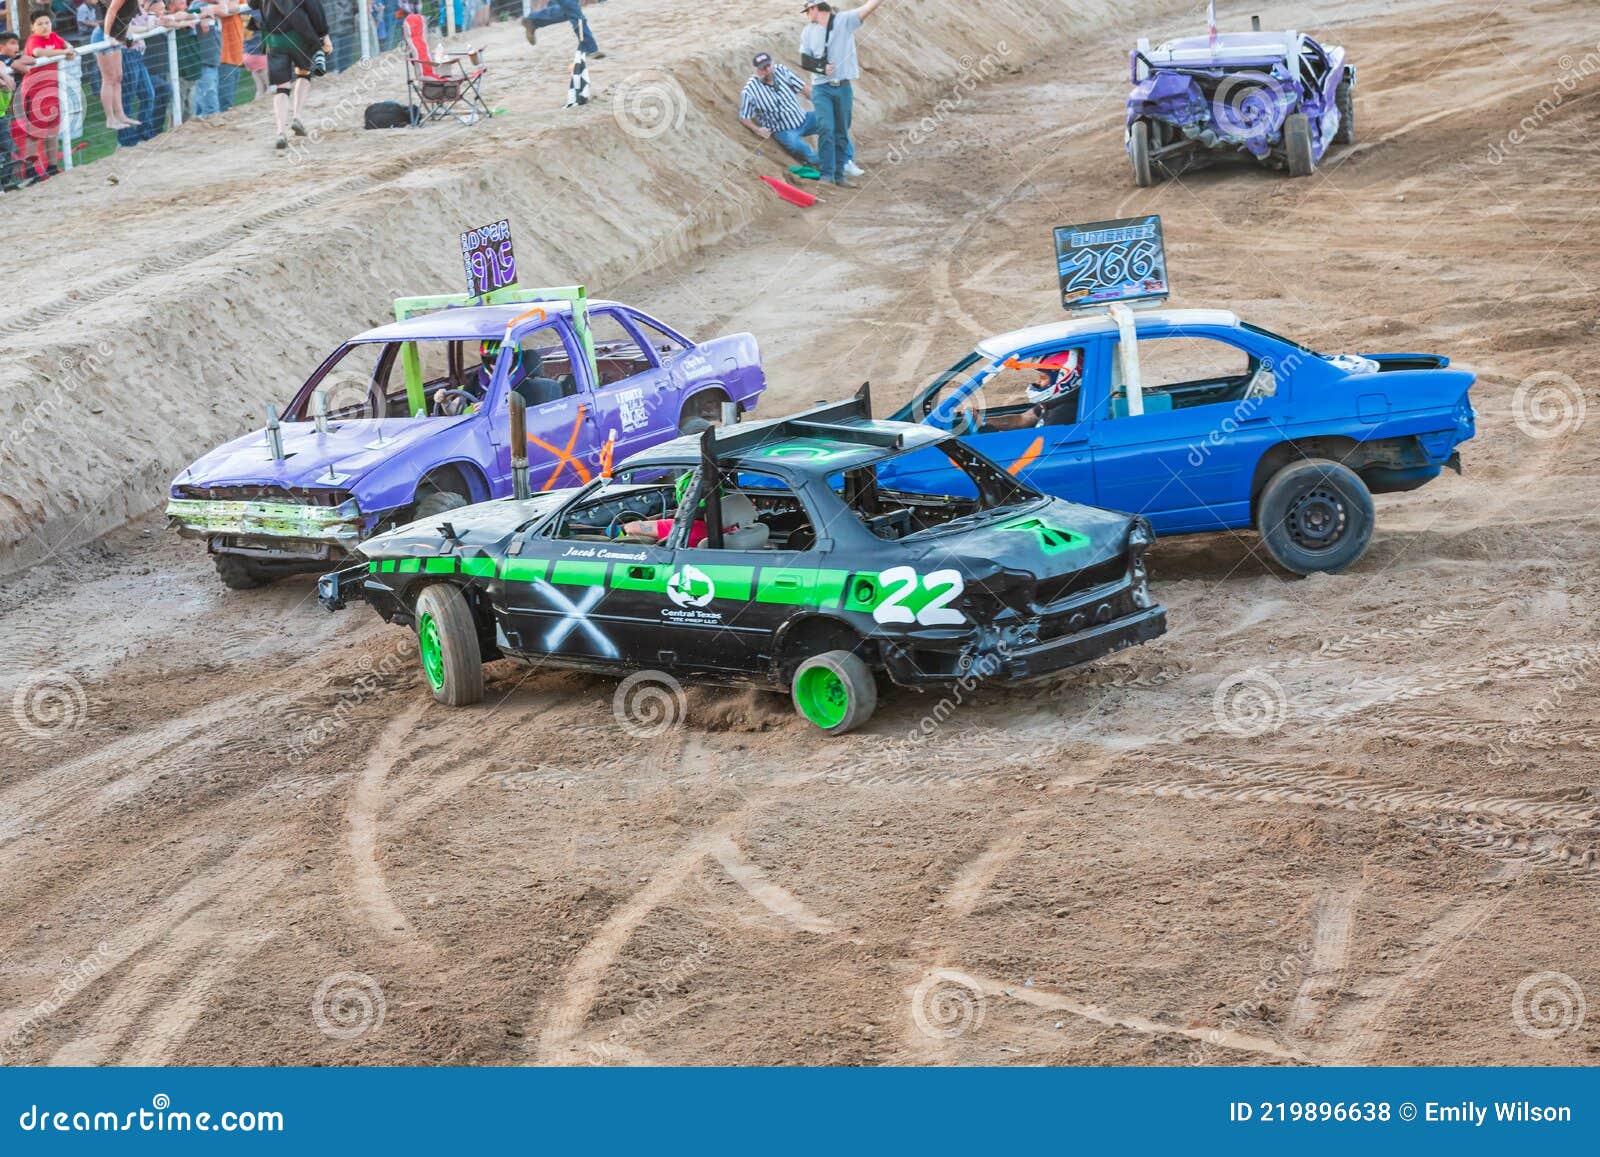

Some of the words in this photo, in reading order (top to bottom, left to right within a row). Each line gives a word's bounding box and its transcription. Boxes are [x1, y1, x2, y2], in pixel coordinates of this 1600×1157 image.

[472, 241, 515, 292] 915
[1066, 241, 1156, 292] 266
[562, 546, 596, 558] Jacob
[661, 608, 695, 619] Central
[696, 610, 722, 619] Texas
[872, 565, 967, 626] 22
